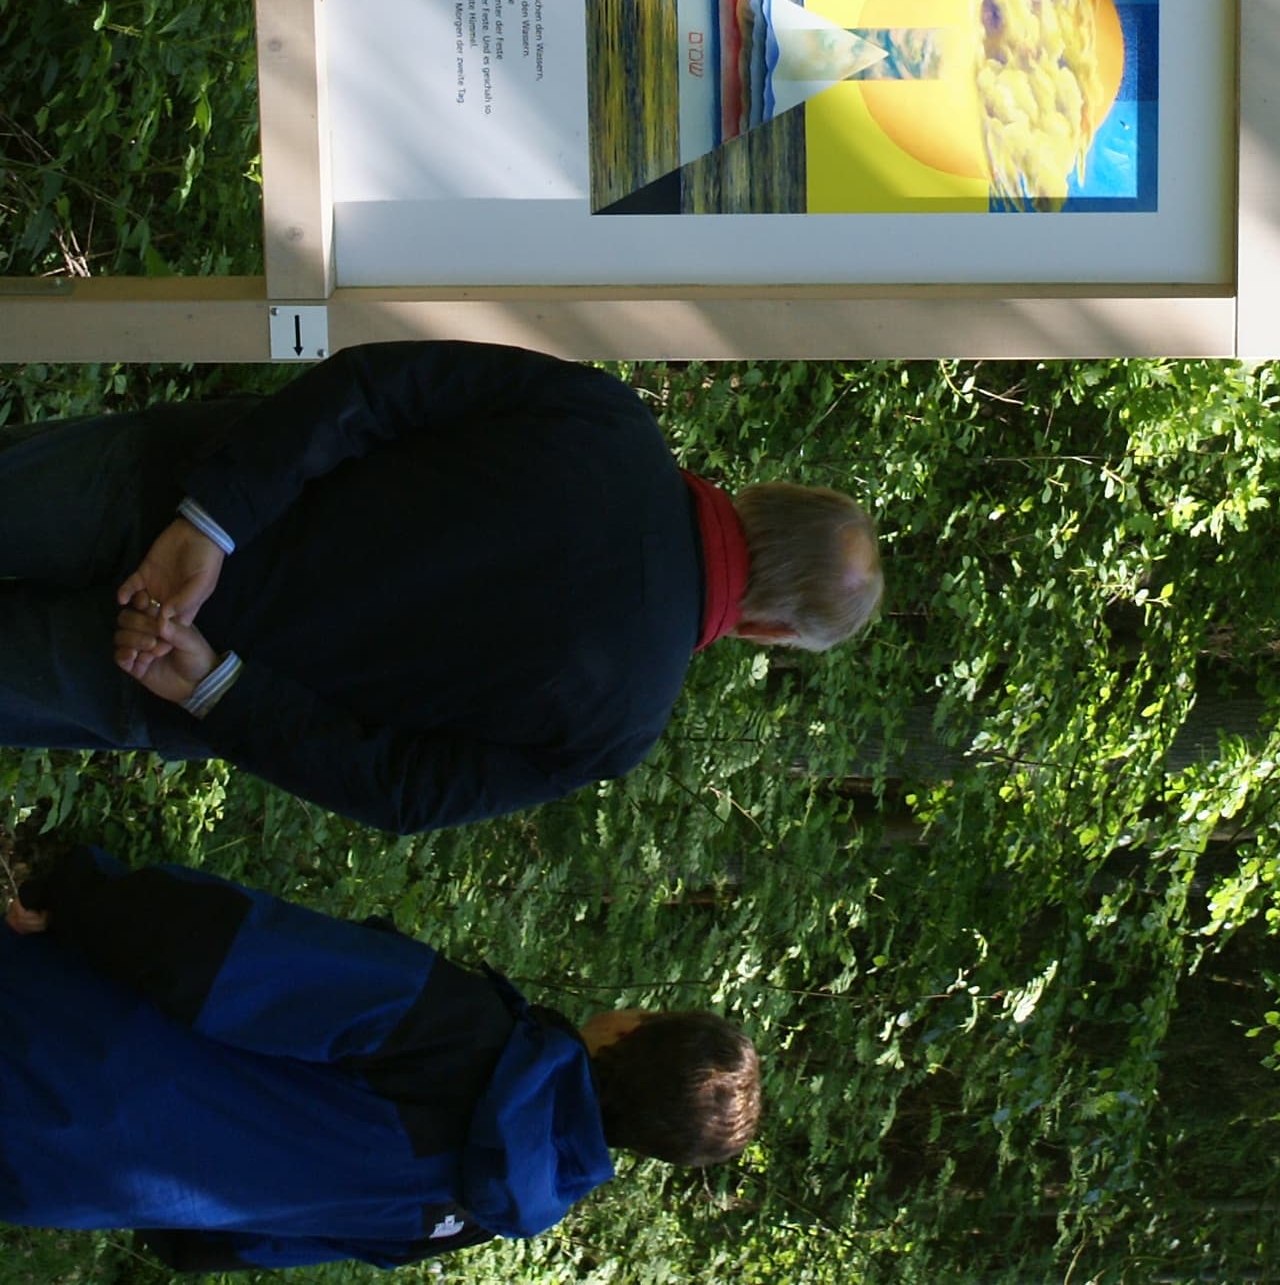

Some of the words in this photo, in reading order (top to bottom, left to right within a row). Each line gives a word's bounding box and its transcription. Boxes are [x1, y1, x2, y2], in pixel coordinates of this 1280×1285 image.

[454, 3, 464, 37] Morgen
[457, 58, 465, 85] zweite
[484, 56, 489, 65] es
[482, 68, 492, 102] geschah
